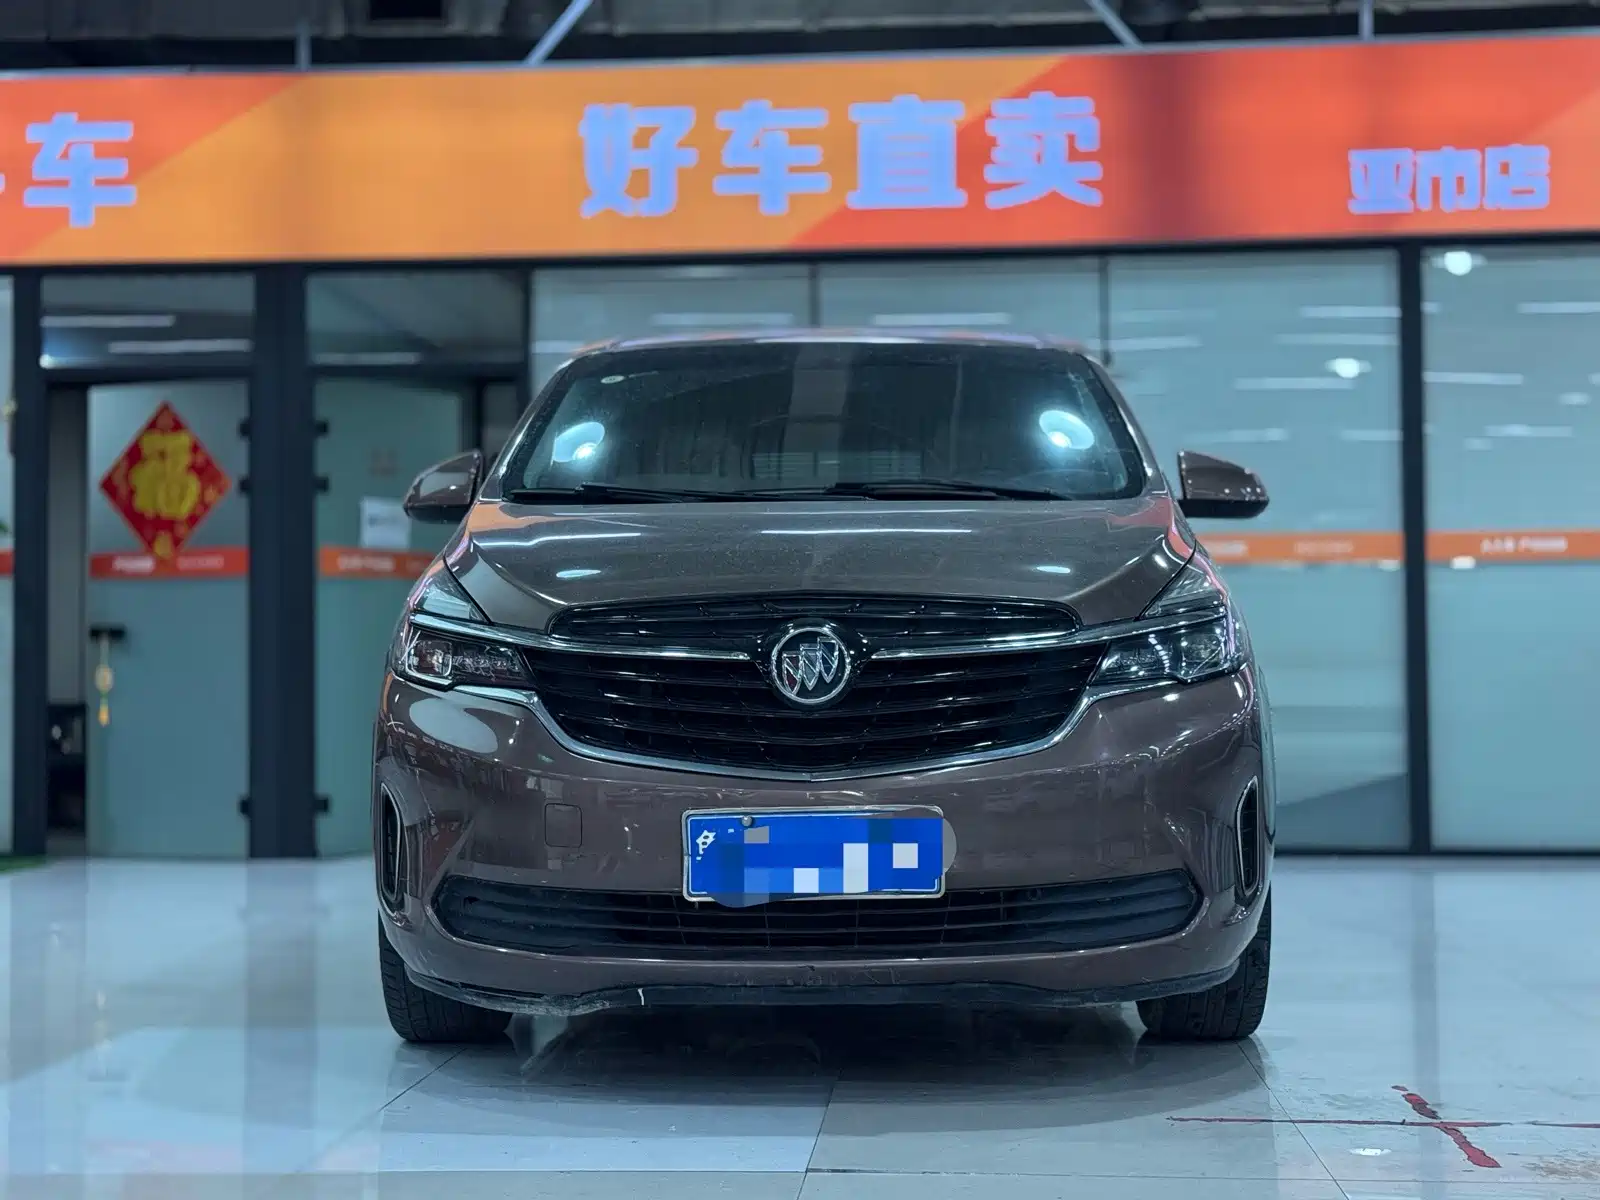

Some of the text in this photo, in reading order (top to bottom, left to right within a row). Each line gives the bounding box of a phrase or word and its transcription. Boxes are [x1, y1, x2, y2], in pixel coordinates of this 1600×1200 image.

[0, 112, 137, 228] 车
[578, 91, 1104, 219] 好车直卖
[1347, 143, 1551, 216] 亚市店
